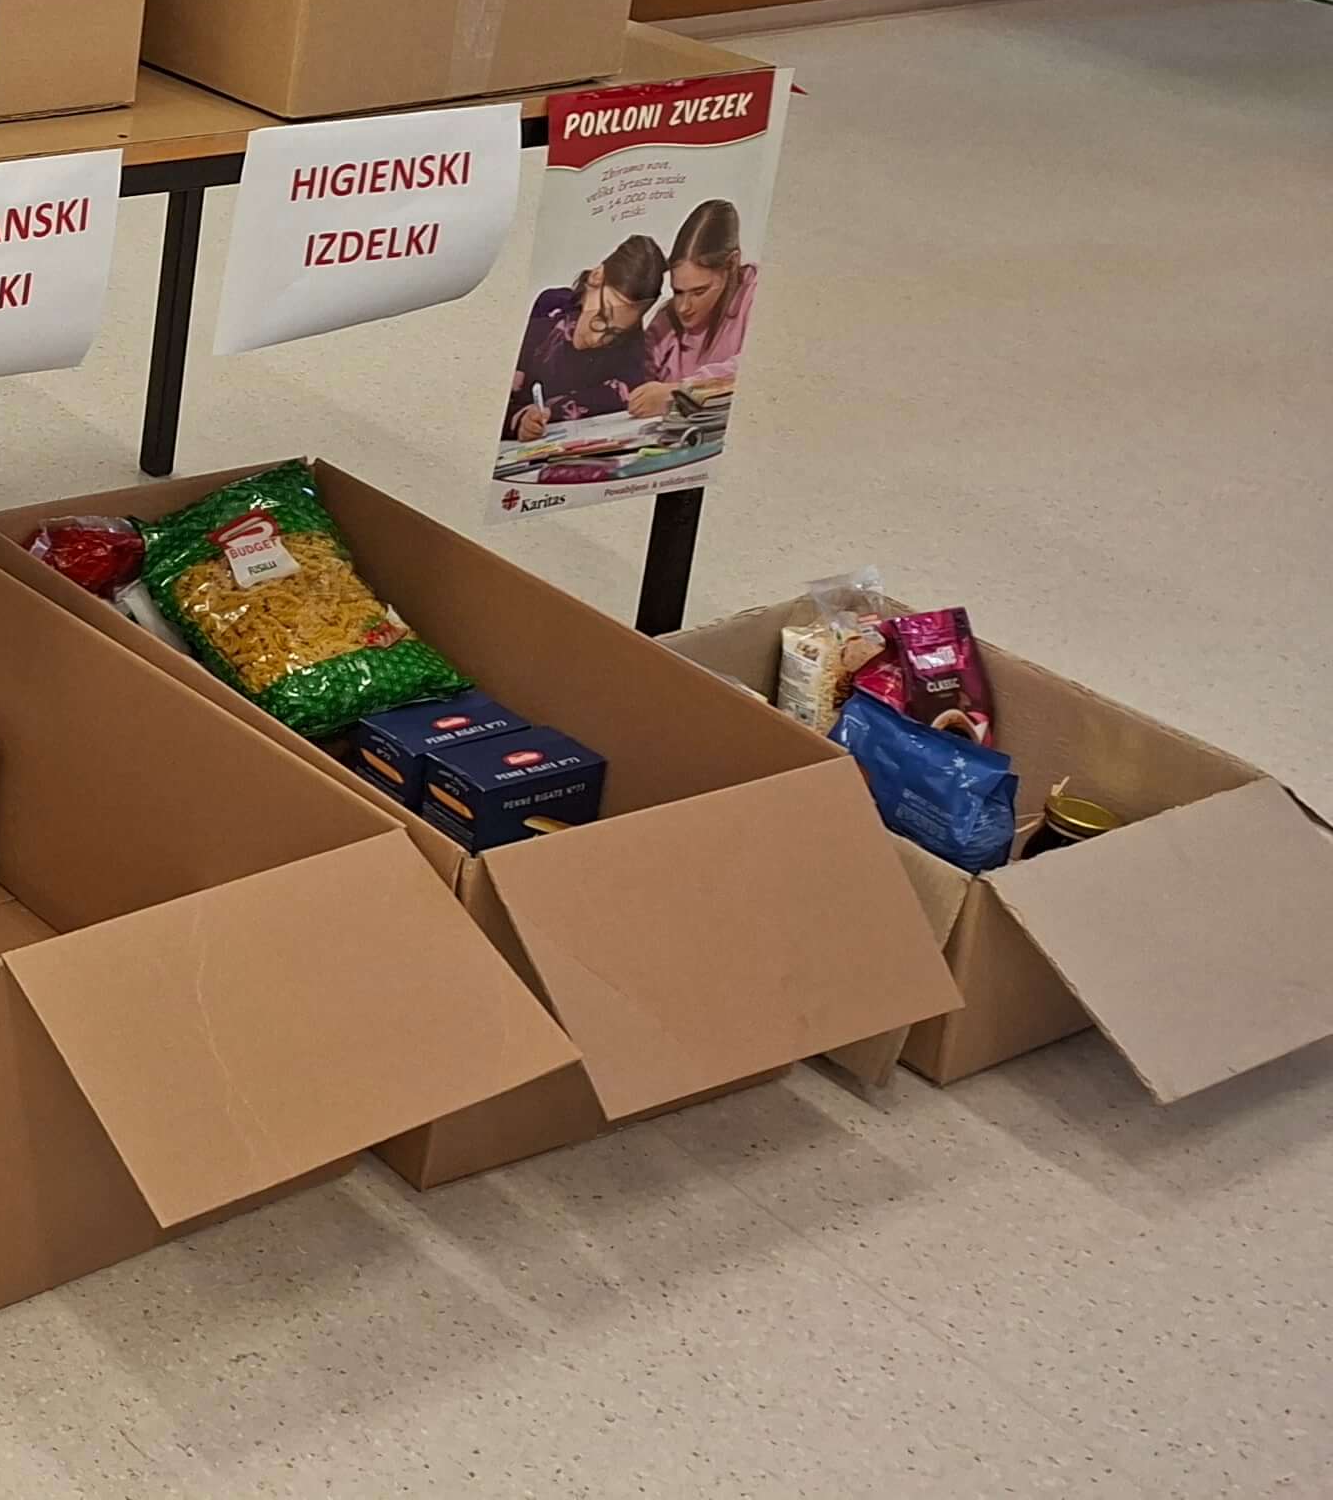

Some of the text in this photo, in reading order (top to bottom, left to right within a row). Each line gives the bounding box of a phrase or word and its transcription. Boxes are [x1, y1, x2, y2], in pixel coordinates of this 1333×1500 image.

[564, 92, 753, 140] POKLONI ZVEZEK
[290, 151, 471, 202] HIGIENSKI
[304, 222, 440, 267] IZDELKI
[520, 493, 566, 513] Karitas
[229, 538, 278, 559] BUDGET
